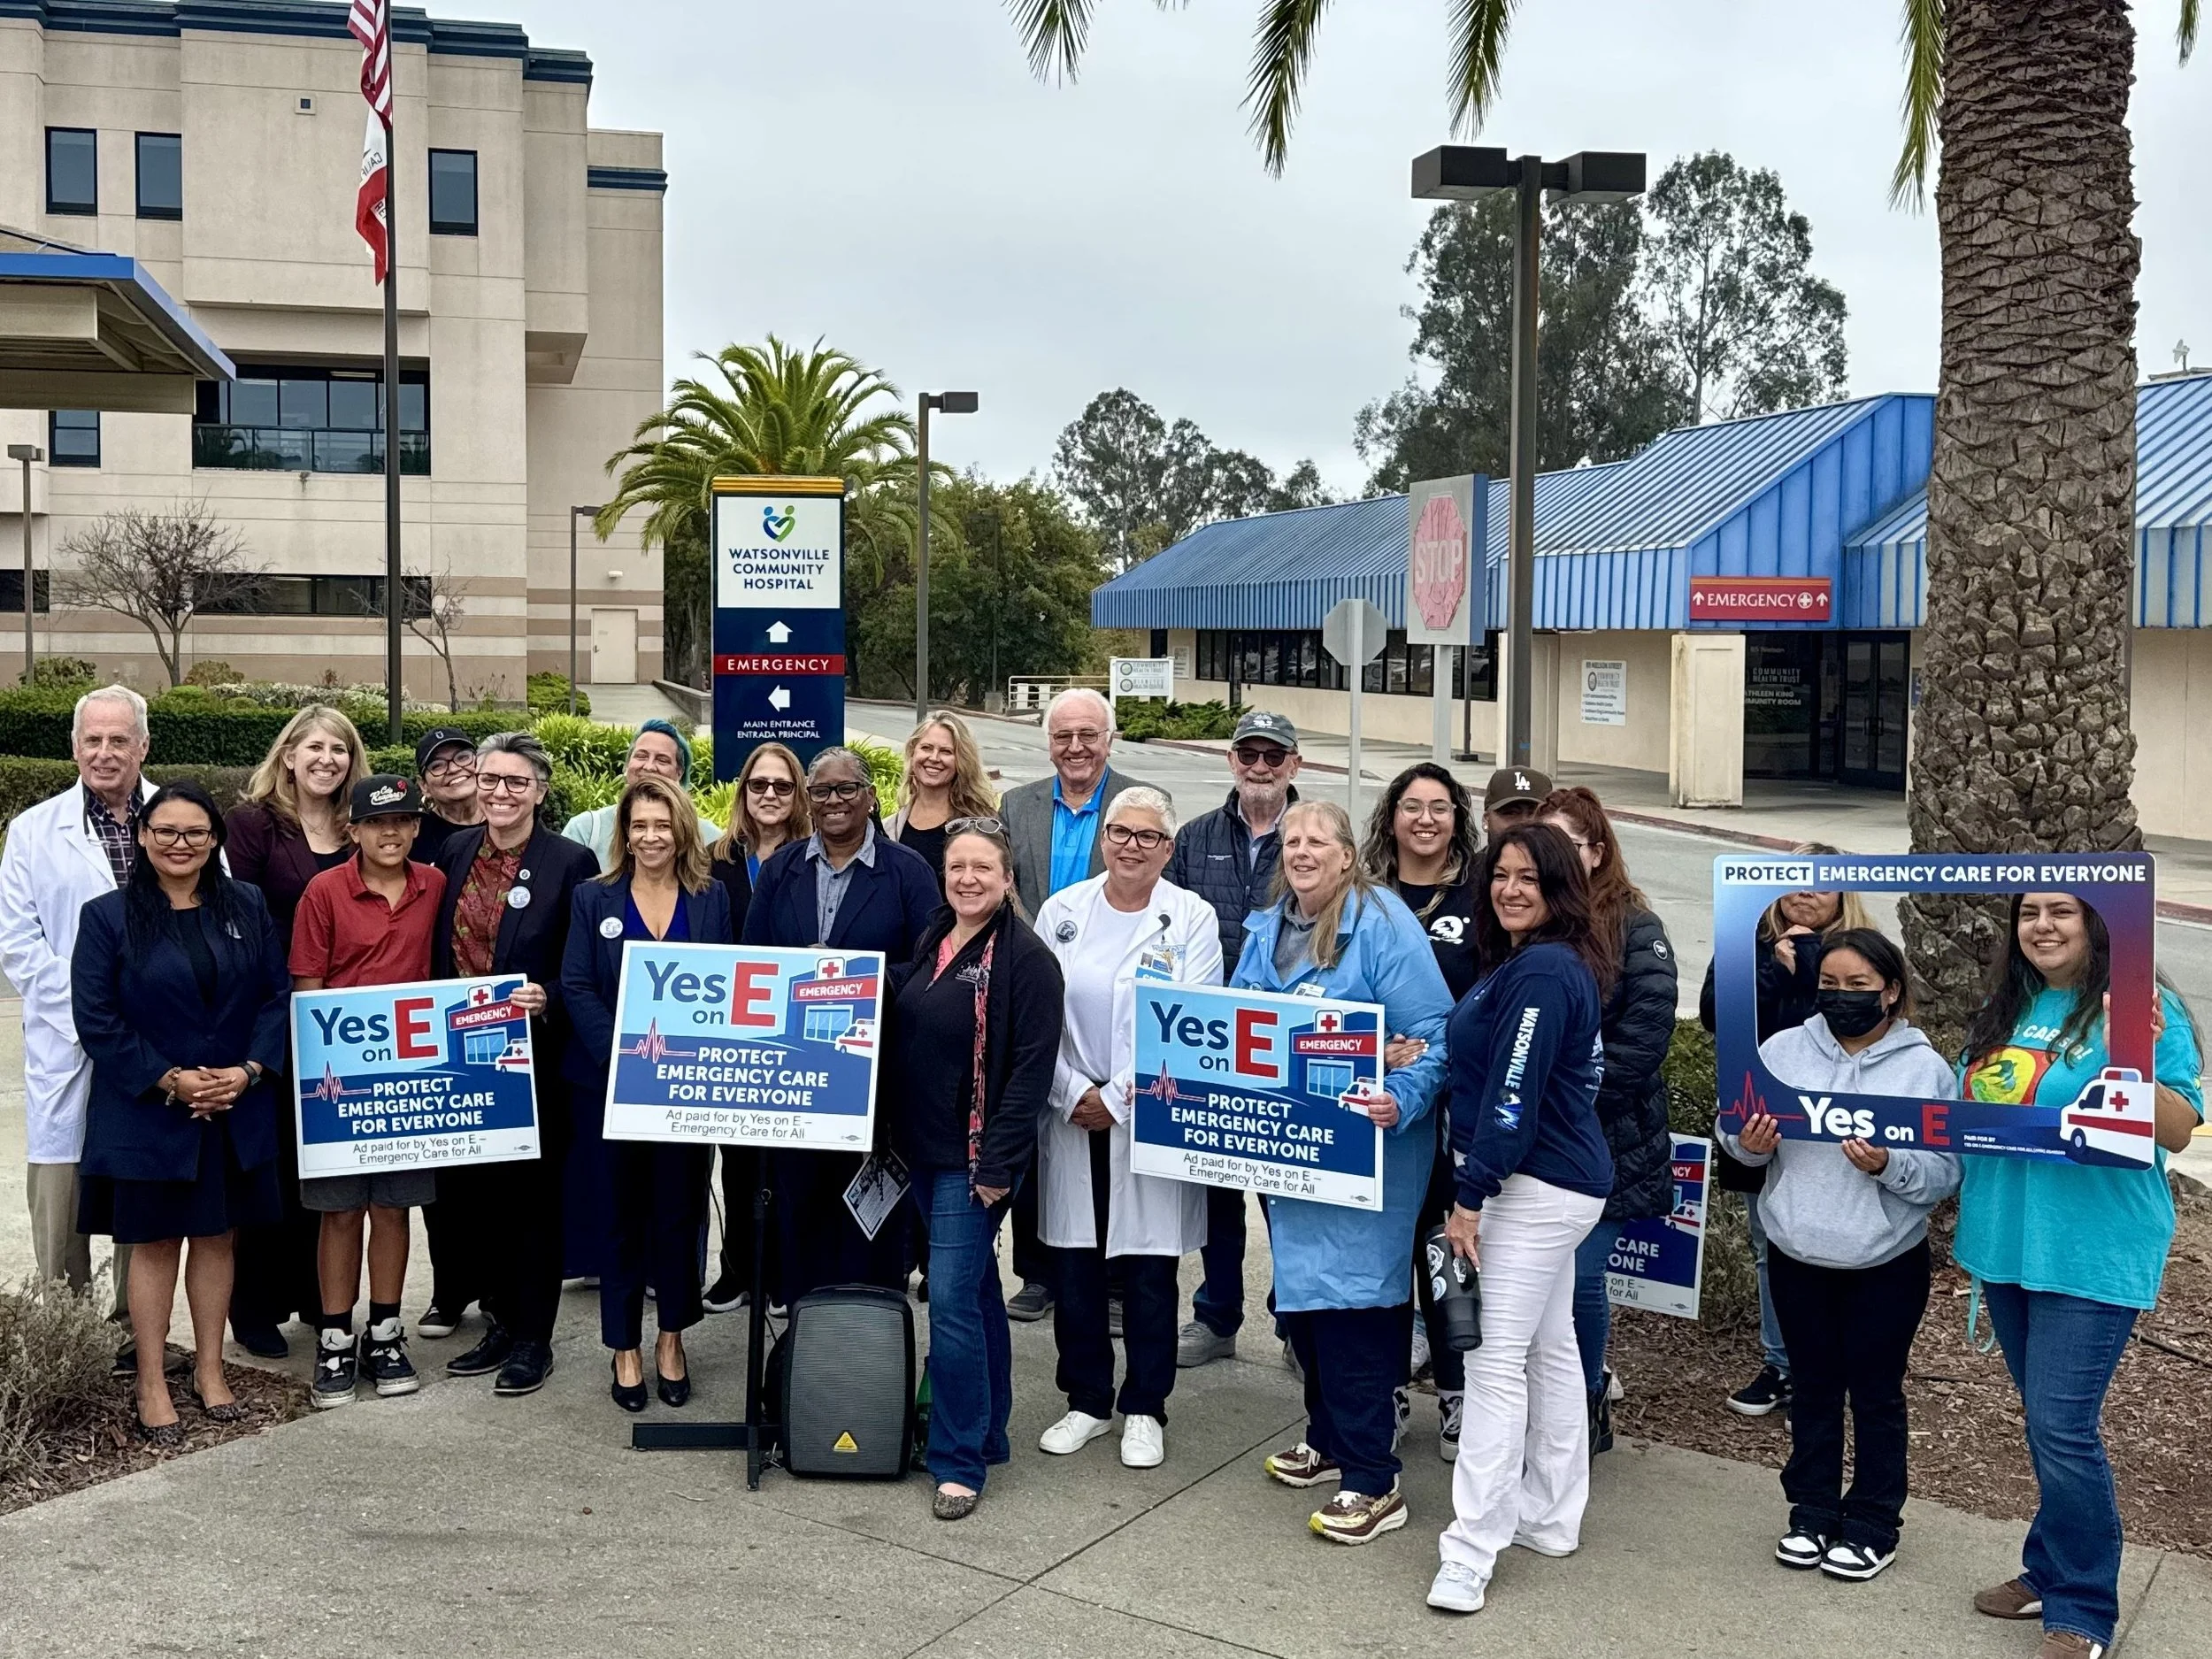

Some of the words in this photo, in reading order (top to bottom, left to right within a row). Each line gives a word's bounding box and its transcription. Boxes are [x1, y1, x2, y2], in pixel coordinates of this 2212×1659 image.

[728, 548, 830, 560] WATSONVILLE
[1416, 540, 1463, 584] STOP
[733, 564, 825, 575] COMMUNITY
[743, 578, 814, 590] HOSPITAL
[1707, 594, 1797, 607] EMERGENCY
[727, 658, 830, 671] EMERGENCY
[737, 730, 776, 739] ENTRADA
[1514, 772, 1531, 790] LA
[1724, 866, 1809, 881] PROTECT
[1819, 866, 1934, 882] EMERGENCY
[1940, 866, 1992, 882] CARE
[1996, 866, 2036, 882] FOR
[2040, 865, 2147, 882] EVERYONE
[643, 960, 726, 1002] Yes
[731, 961, 780, 1027] E
[799, 982, 863, 997] EMERGENCY
[455, 1005, 512, 1025] EMERGENCY
[692, 1010, 725, 1025] on
[310, 1007, 390, 1046] Yes
[395, 996, 439, 1060] E
[1149, 1001, 1229, 1051] Yes
[1235, 1008, 1279, 1079] E
[1300, 1039, 1363, 1051] EMERGENCY
[1504, 1007, 1540, 1089] WATSONVILLE
[362, 1048, 391, 1062] on
[698, 1046, 787, 1066] PROTECT
[1199, 1055, 1229, 1072] on
[657, 1064, 776, 1085] EMERGENCY
[778, 1069, 829, 1088] CARE
[373, 1077, 454, 1097] PROTECT
[668, 1084, 706, 1101] FOR
[712, 1086, 813, 1107] EVERYONE
[338, 1097, 445, 1118] EMERGENCY
[449, 1092, 495, 1110] CARE
[1209, 1093, 1292, 1118] PROTECT
[352, 1118, 387, 1134] FOR
[392, 1110, 483, 1132] EVERYONE
[665, 1110, 682, 1120] Ad
[686, 1110, 710, 1125] paid
[713, 1111, 729, 1122] for
[732, 1113, 747, 1125] by
[749, 1114, 771, 1125] Yes
[774, 1117, 788, 1125] on
[793, 1115, 802, 1126] E
[1171, 1108, 1281, 1137] EMERGENCY
[1286, 1124, 1334, 1145] CARE
[1798, 1095, 1875, 1139] Yes
[1884, 1125, 1915, 1142] on
[1921, 1103, 1951, 1146] E
[672, 1122, 736, 1138] Emergency
[741, 1125, 769, 1138] Care
[772, 1126, 787, 1138] for
[789, 1128, 805, 1139] All
[353, 1143, 368, 1154] Ad
[371, 1141, 394, 1154] paid
[396, 1140, 411, 1150] for
[413, 1139, 426, 1151] by
[429, 1136, 449, 1148] Yes
[451, 1136, 465, 1145] on
[468, 1134, 477, 1144] E
[1184, 1128, 1219, 1147] FOR
[1225, 1136, 1320, 1163] EVERYONE
[359, 1150, 419, 1165] Emergency
[422, 1147, 449, 1159] Care
[452, 1147, 466, 1156] for
[468, 1145, 482, 1156] All
[1184, 1153, 1198, 1164] Ad
[1202, 1155, 1225, 1171] paid
[1227, 1158, 1242, 1170] for
[1245, 1161, 1258, 1175] by
[1261, 1164, 1281, 1177] Yes
[1285, 1171, 1299, 1179] on
[1302, 1171, 1311, 1181] E
[1189, 1166, 1250, 1187] Emergency
[1253, 1175, 1280, 1189] Care
[1283, 1179, 1298, 1192] for
[1301, 1183, 1316, 1194] All
[1614, 1237, 1660, 1257] CARE
[1611, 1278, 1624, 1287] on
[1627, 1279, 1635, 1289] E
[1609, 1287, 1624, 1298] for
[1624, 1289, 1639, 1301] All
